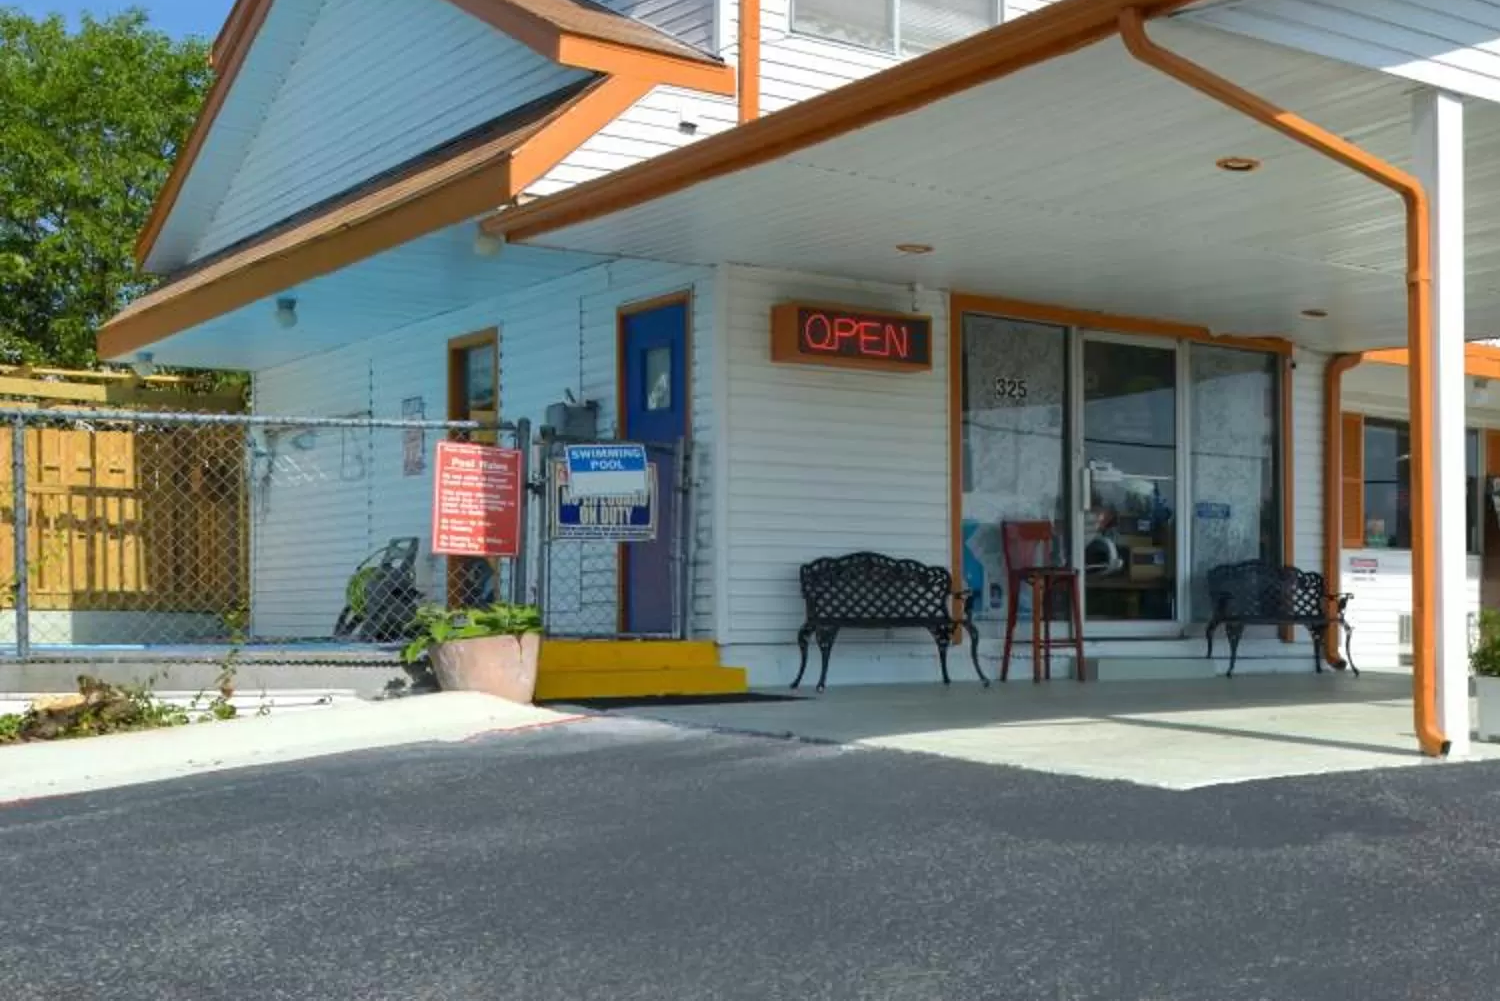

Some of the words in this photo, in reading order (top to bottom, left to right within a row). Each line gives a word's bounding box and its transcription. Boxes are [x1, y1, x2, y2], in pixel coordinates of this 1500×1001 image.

[804, 313, 908, 359] OPEN
[995, 377, 1028, 399] 325
[571, 448, 642, 459] SWIMMING
[590, 460, 624, 471] POOL
[579, 507, 598, 525] ON
[601, 507, 633, 526] DUTY
